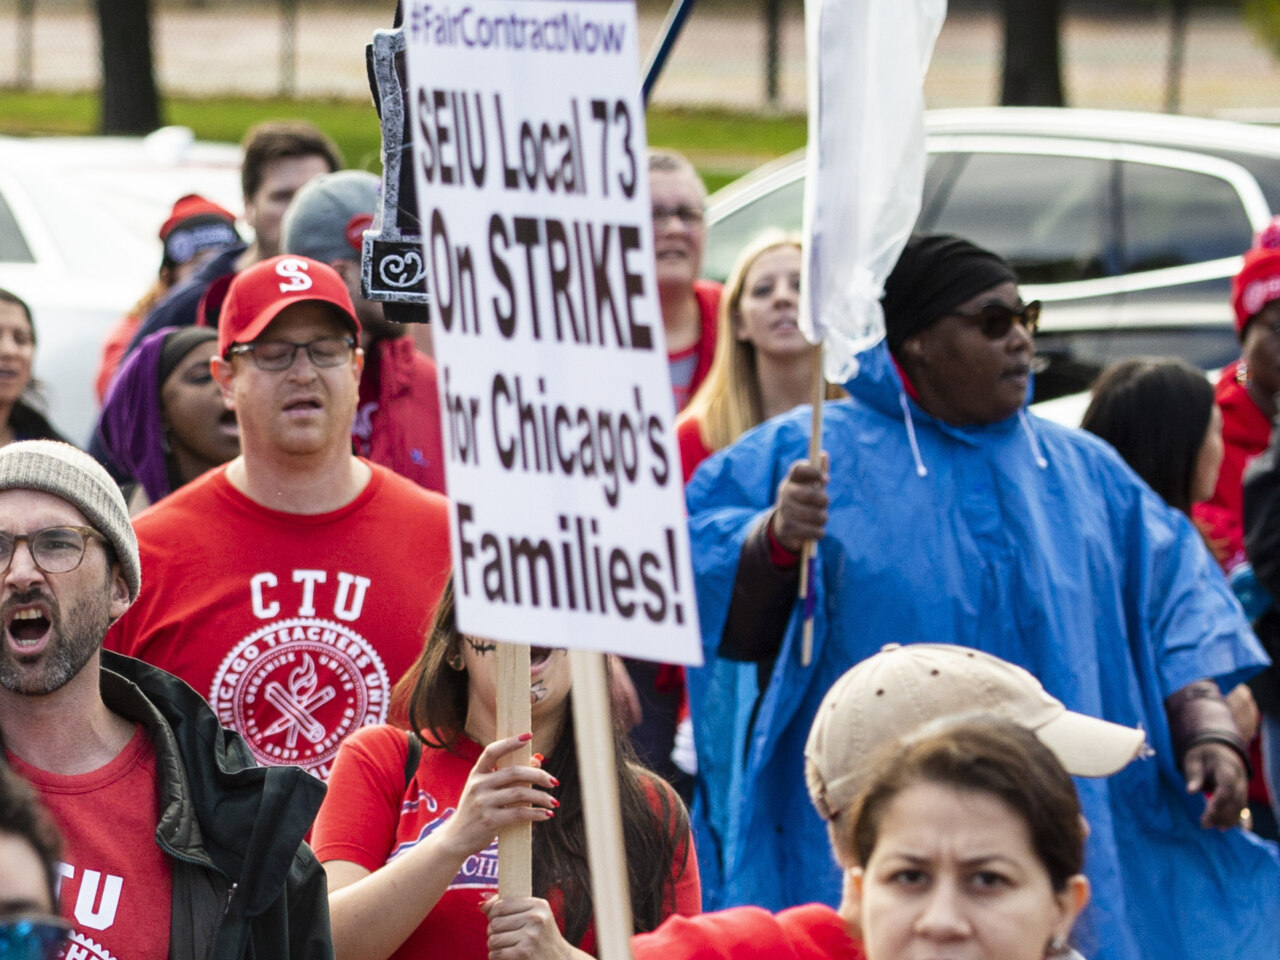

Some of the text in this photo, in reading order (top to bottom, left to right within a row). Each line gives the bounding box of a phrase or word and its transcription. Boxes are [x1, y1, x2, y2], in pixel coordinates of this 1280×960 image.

[411, 4, 626, 54] #FairContractNow
[418, 87, 637, 200] SEIU Local 73
[430, 208, 655, 351] On STRIKE
[444, 366, 670, 509] for Chicago's
[250, 569, 372, 622] CTU
[456, 501, 686, 627] Families!
[262, 626, 370, 669] TEACHERS
[245, 651, 356, 754] ORGANIZE UNITE DEFEND
[264, 742, 300, 760] 1937
